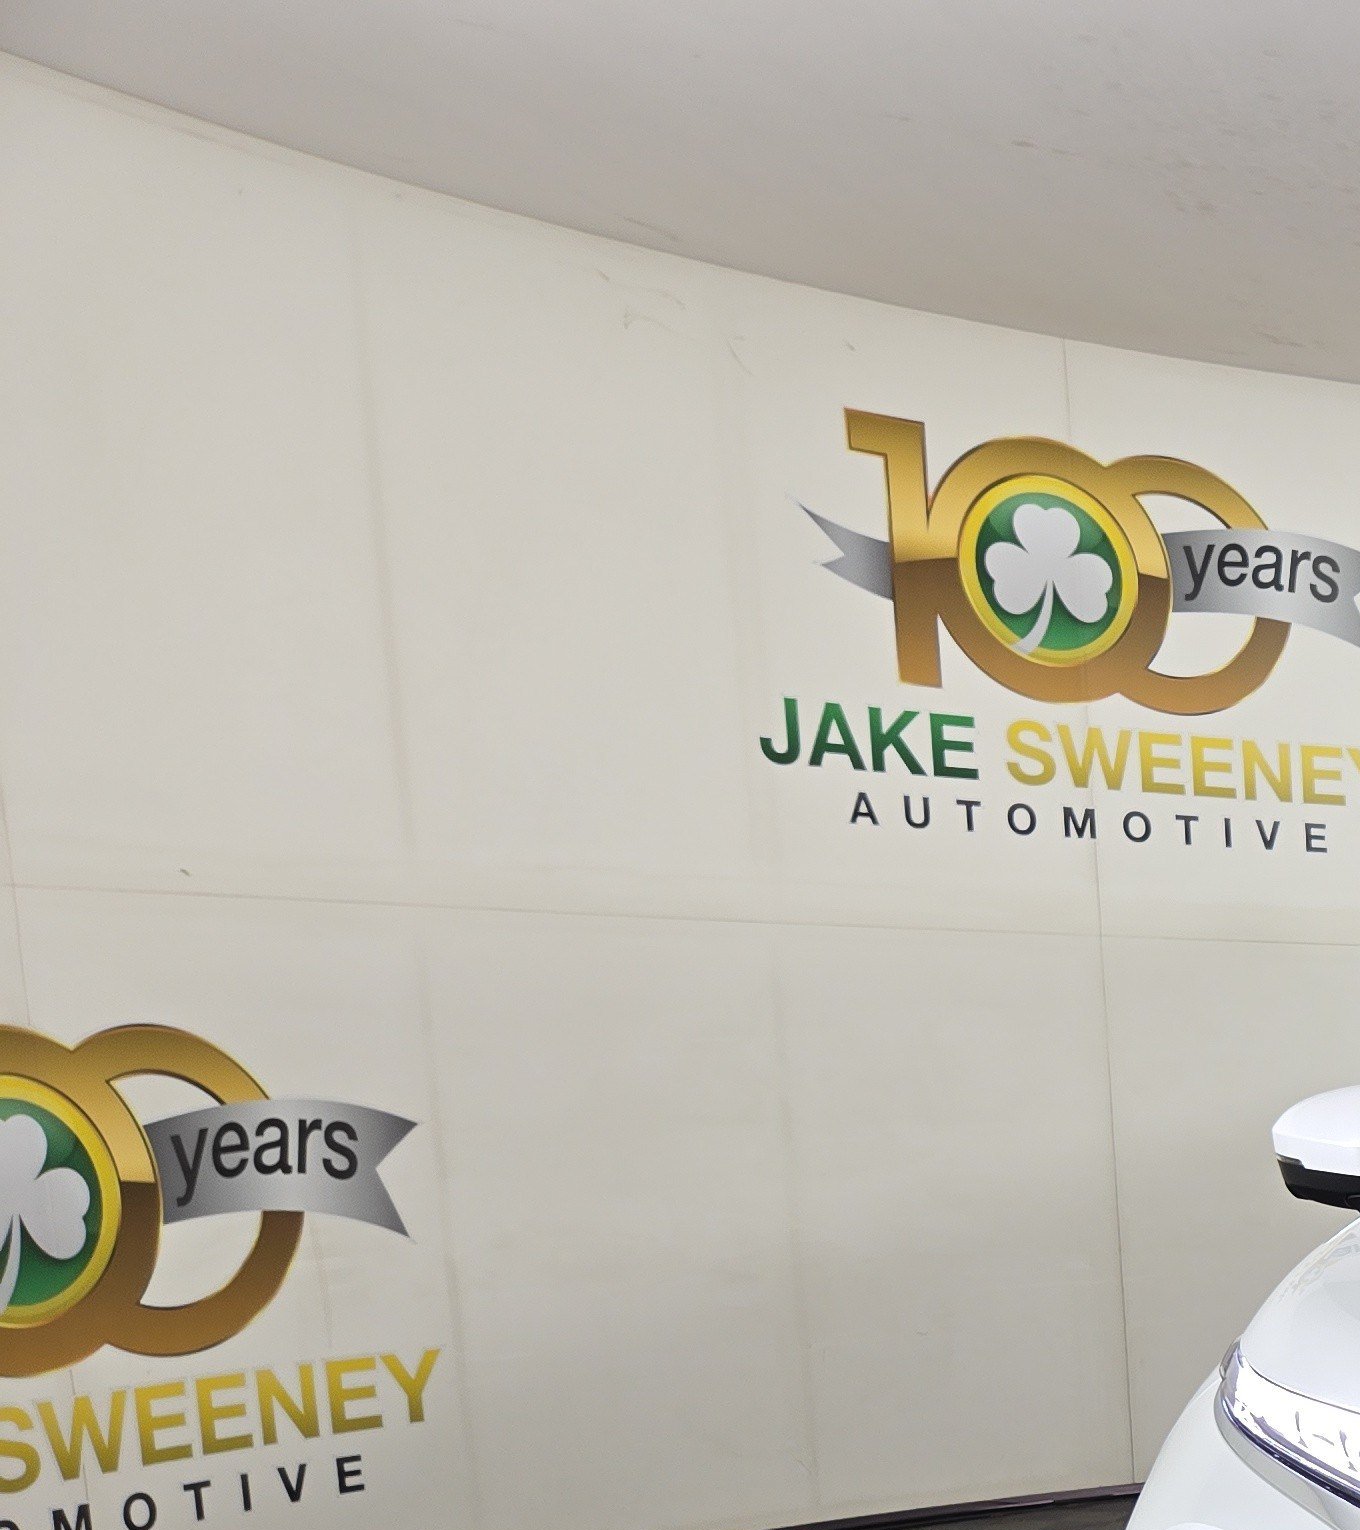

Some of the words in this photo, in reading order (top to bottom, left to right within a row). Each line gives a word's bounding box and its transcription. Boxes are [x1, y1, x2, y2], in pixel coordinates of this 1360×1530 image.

[843, 406, 1292, 717] 100
[1182, 540, 1342, 604] years
[759, 696, 980, 780] JAKE
[849, 791, 1329, 854] AUTOMOTIVE
[169, 1116, 360, 1208] years
